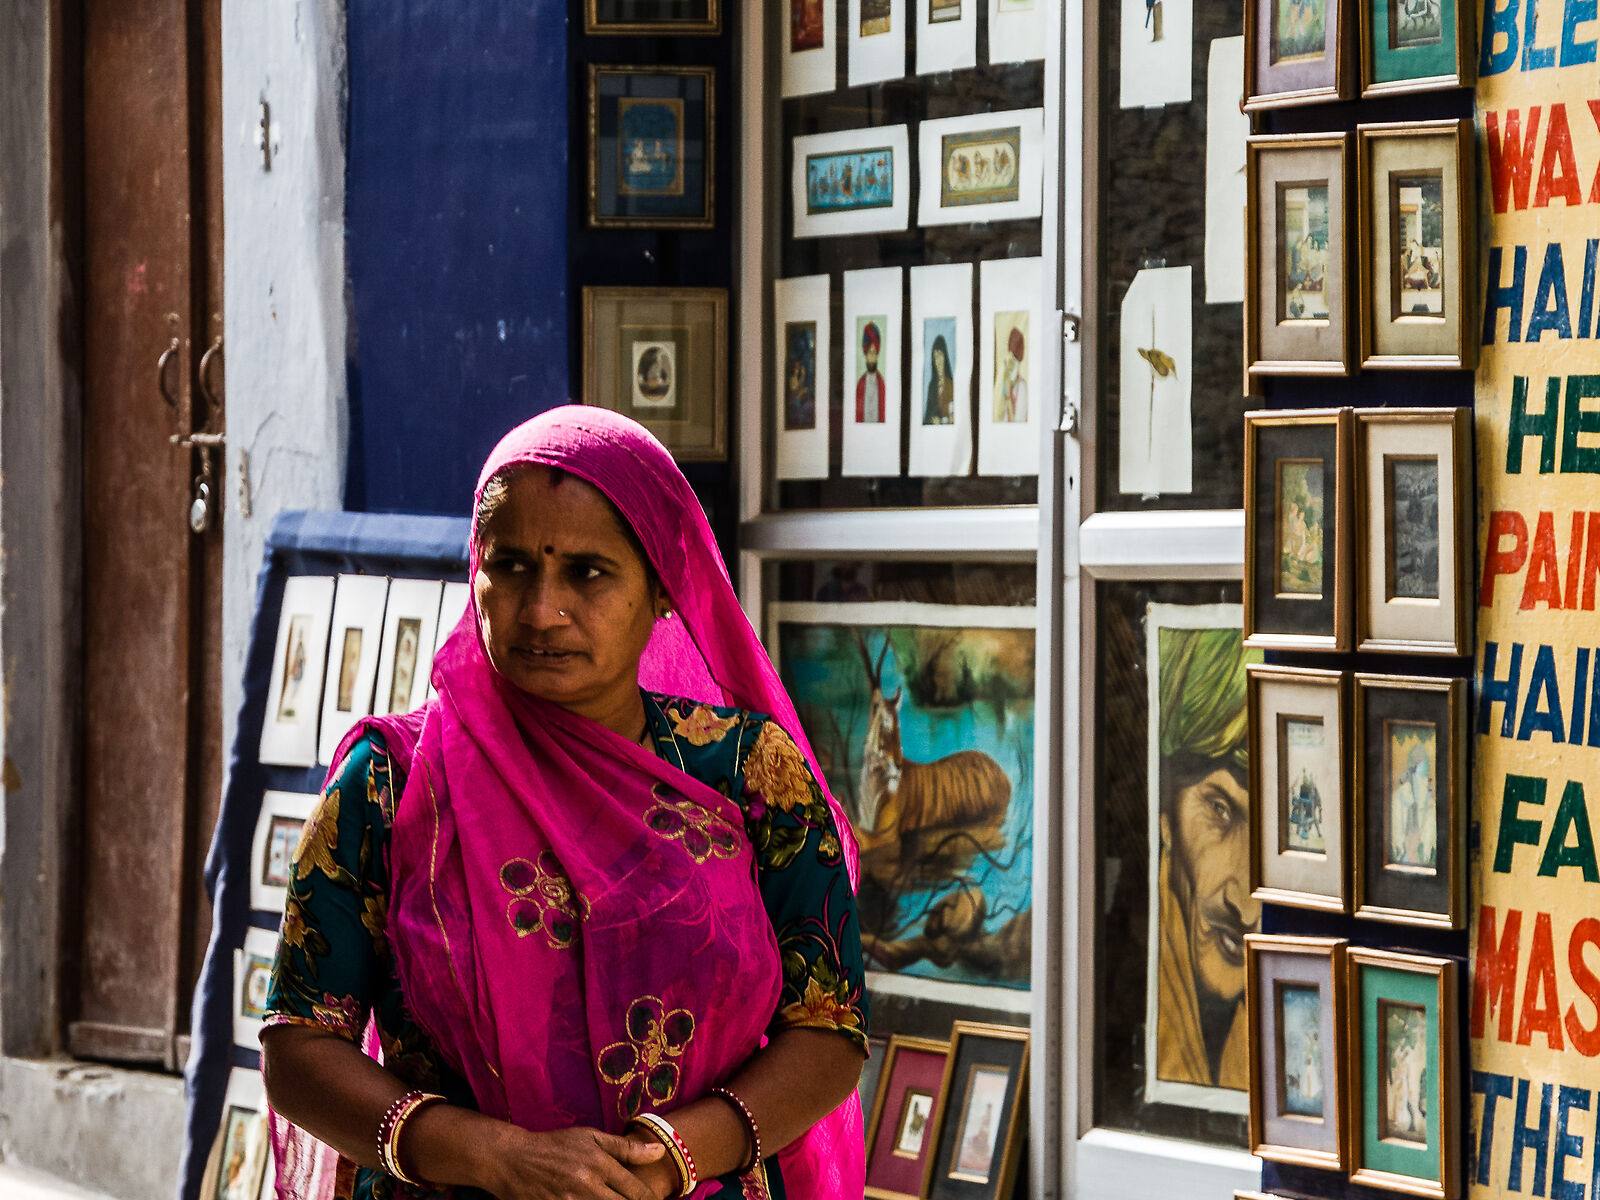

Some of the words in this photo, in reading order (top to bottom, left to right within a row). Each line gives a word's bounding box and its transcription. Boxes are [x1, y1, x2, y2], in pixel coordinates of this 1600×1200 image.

[1479, 0, 1598, 77] BLE
[1486, 100, 1600, 214] WA
[1482, 239, 1600, 345] HAI
[1493, 774, 1600, 883] FA
[1471, 904, 1600, 1057] MAS
